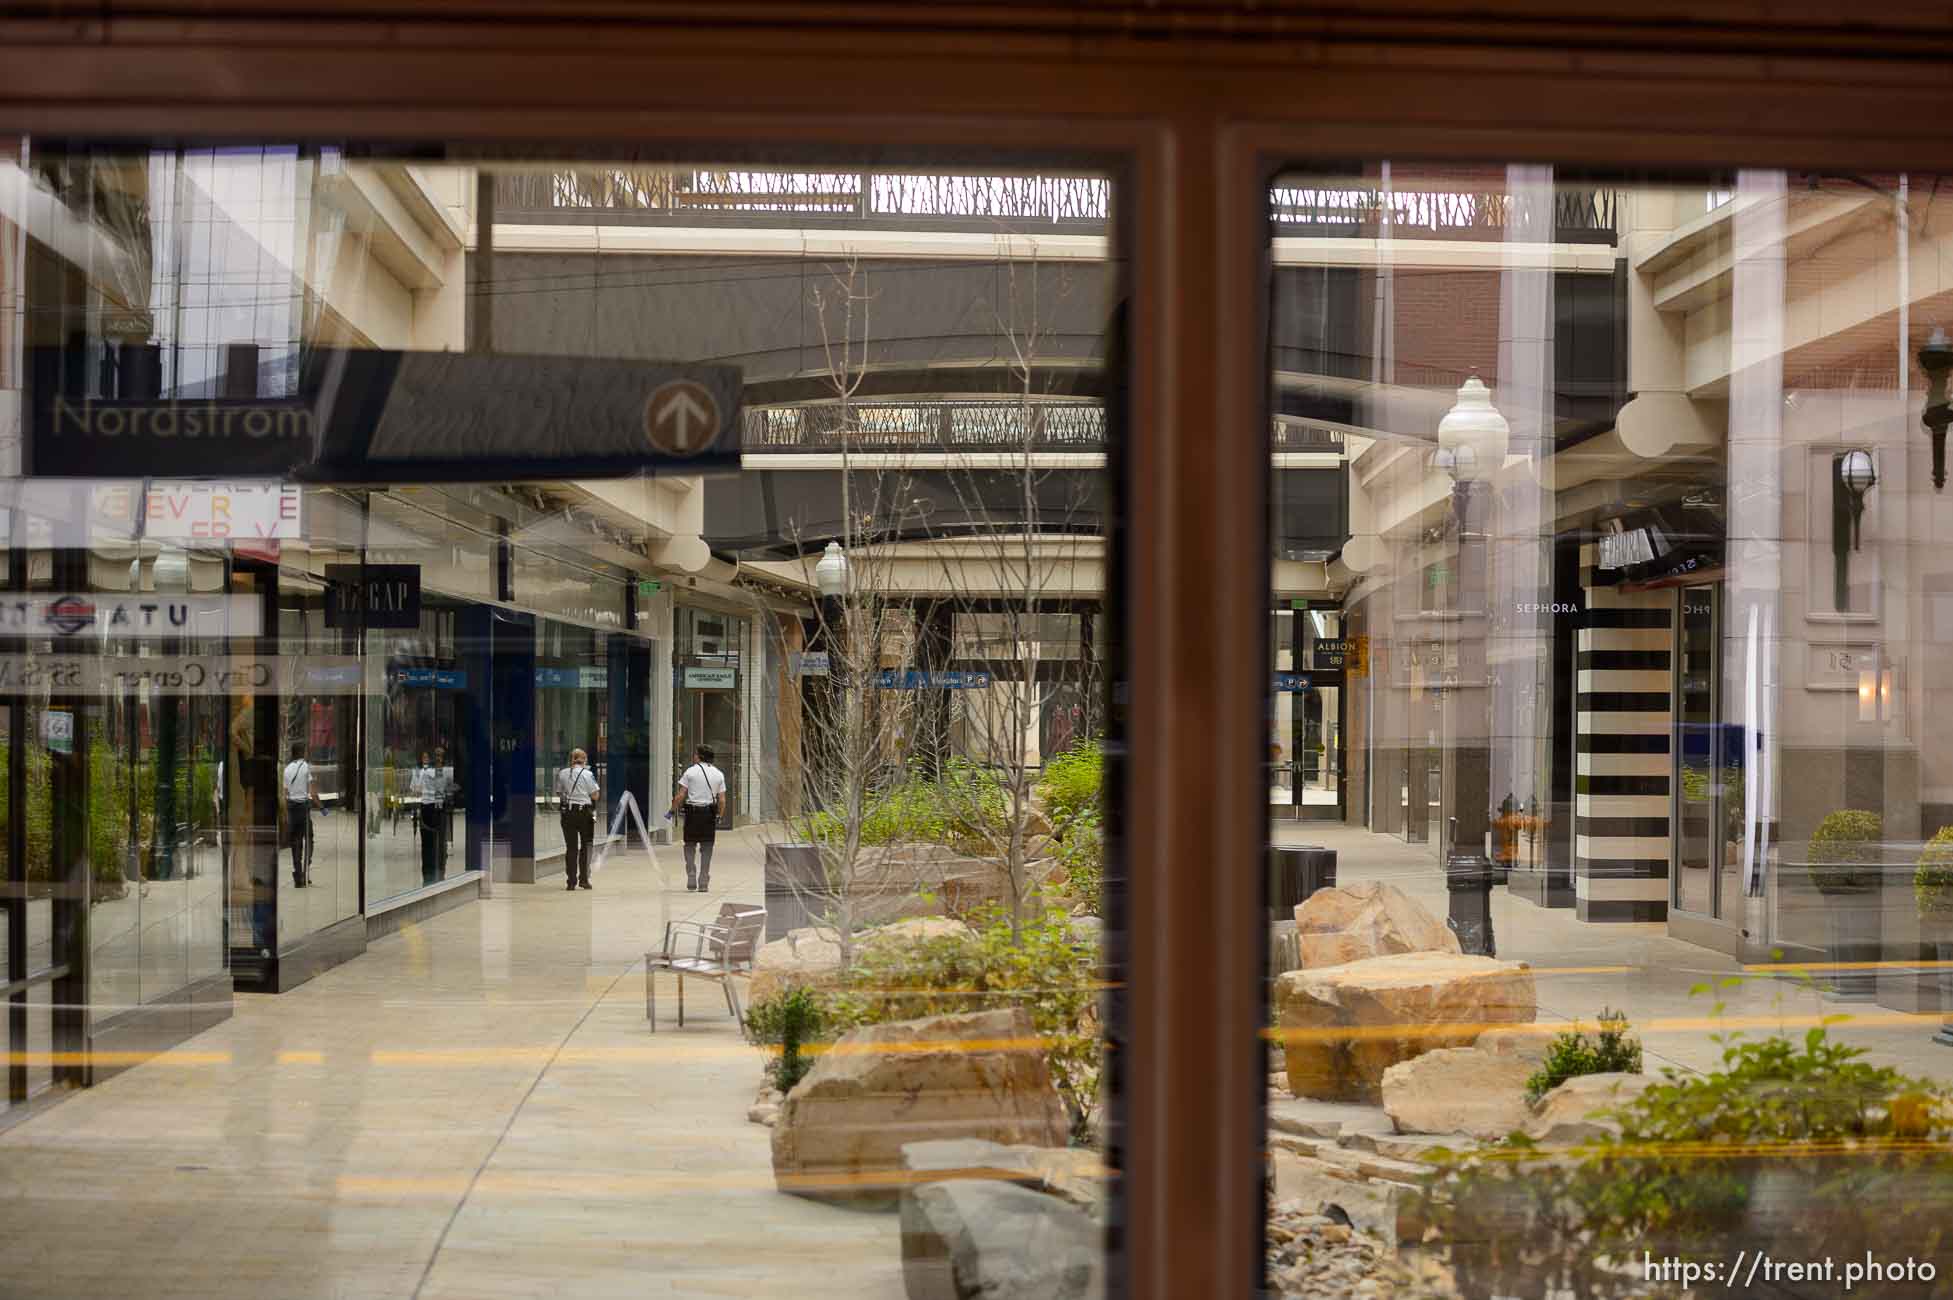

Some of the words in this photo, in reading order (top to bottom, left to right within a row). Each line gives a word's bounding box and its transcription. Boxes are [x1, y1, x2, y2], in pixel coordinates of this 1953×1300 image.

[53, 396, 312, 437] Nordstrom
[369, 581, 408, 612] GAP
[1515, 603, 1579, 614] SEPHORA
[1317, 642, 1357, 651] ALBION
